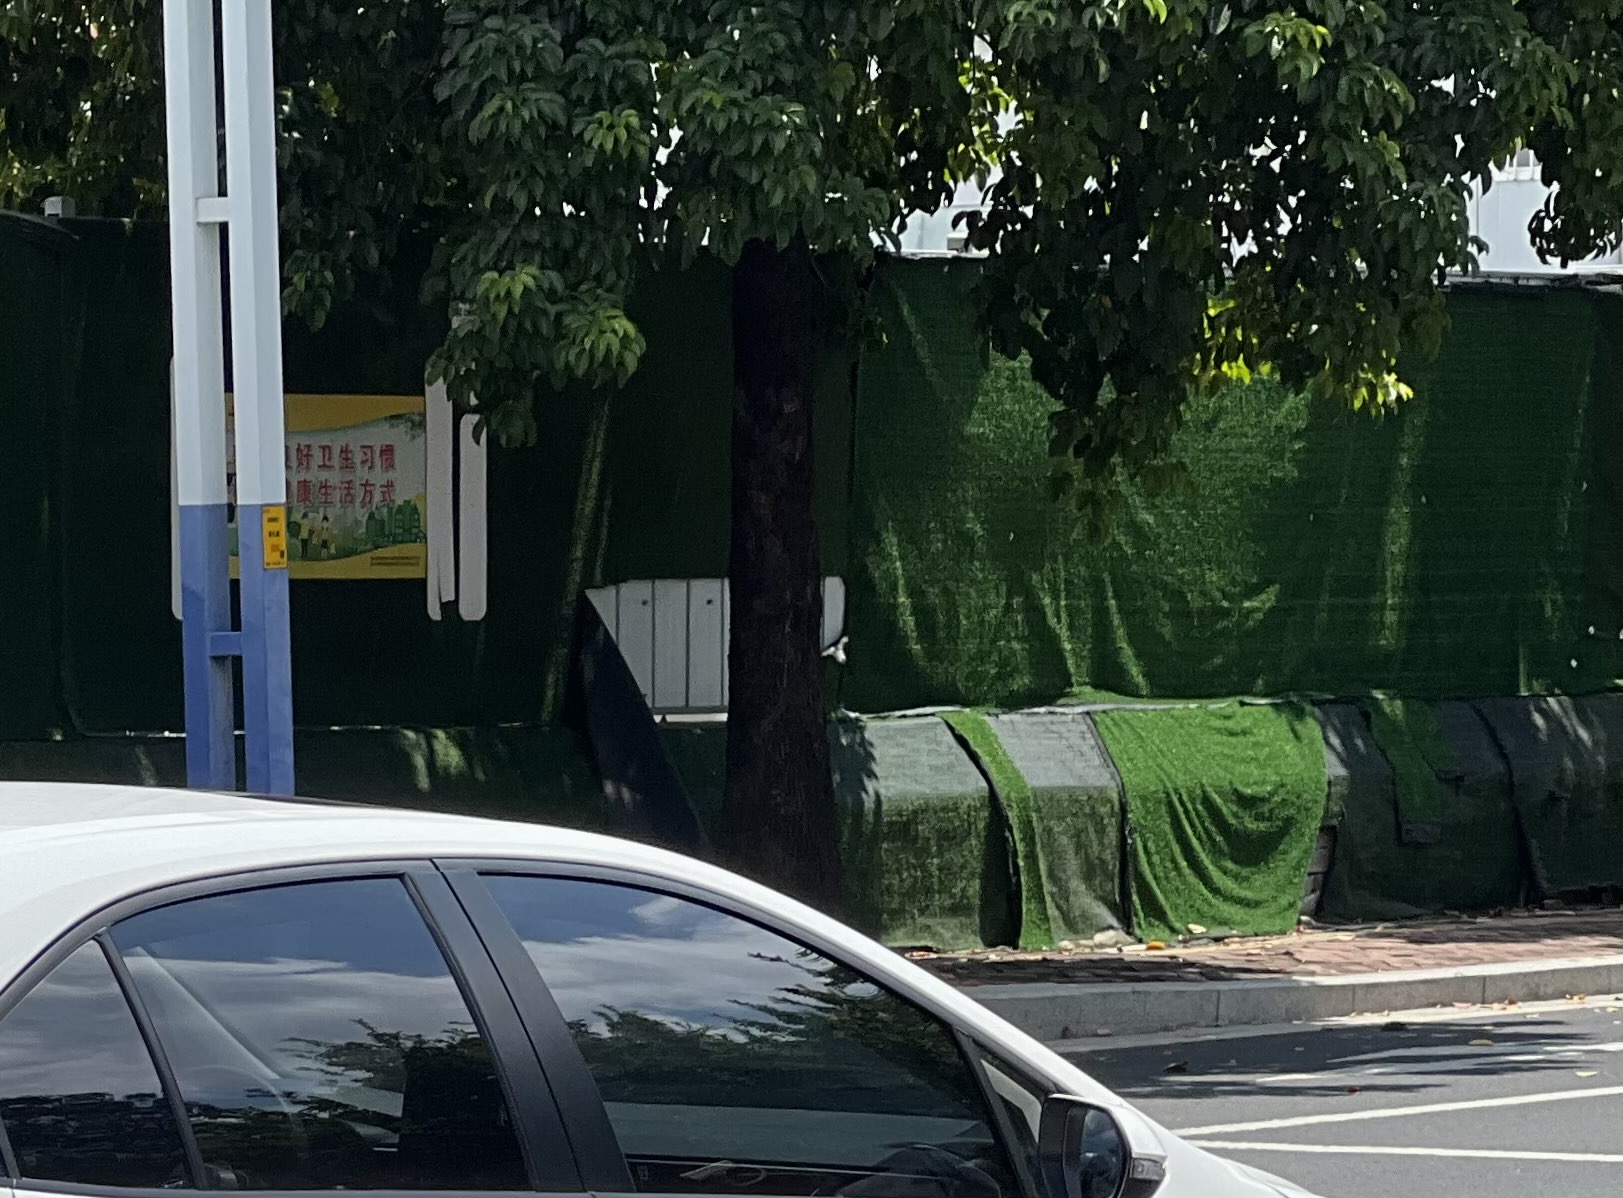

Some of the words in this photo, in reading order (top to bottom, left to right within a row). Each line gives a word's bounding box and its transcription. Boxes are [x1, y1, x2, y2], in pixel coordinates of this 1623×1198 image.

[285, 442, 397, 472] 好卫生习惯
[285, 478, 397, 506] 康生活方式
